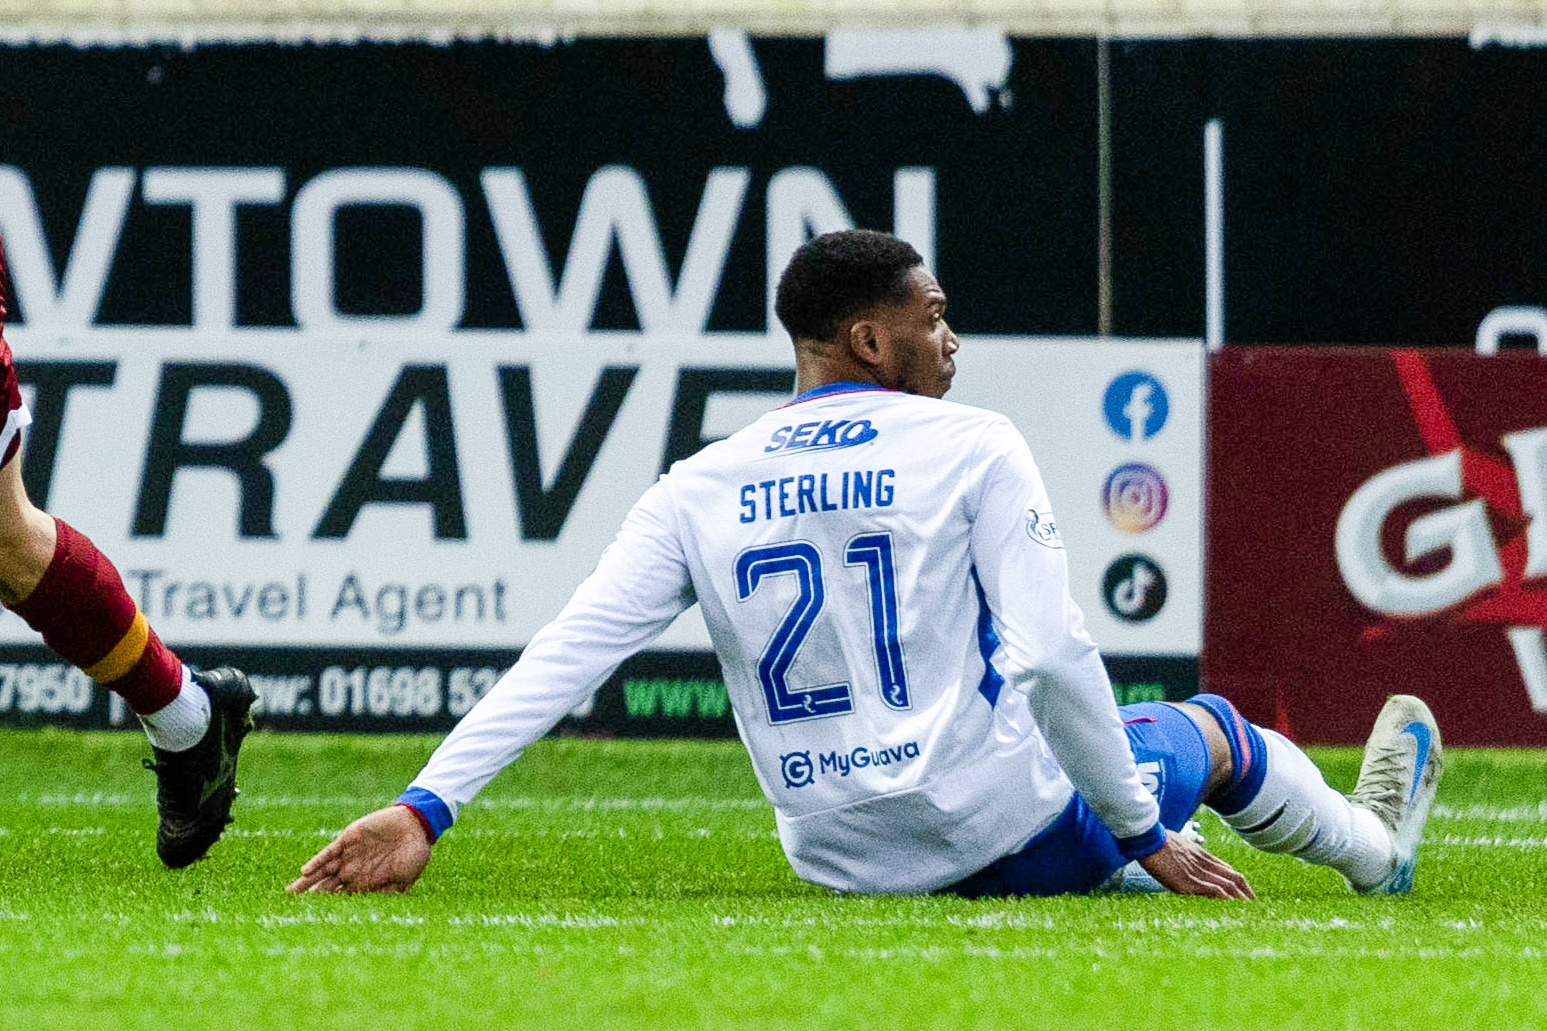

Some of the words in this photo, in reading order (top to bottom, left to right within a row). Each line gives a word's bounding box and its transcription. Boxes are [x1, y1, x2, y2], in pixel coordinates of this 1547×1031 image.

[764, 419, 877, 453] SEKO
[739, 469, 895, 524] STERLING
[128, 568, 308, 620] Travel
[330, 570, 506, 635] Agent
[732, 530, 913, 726] 21
[318, 665, 441, 717] 01698
[819, 740, 920, 778] MyGuava
